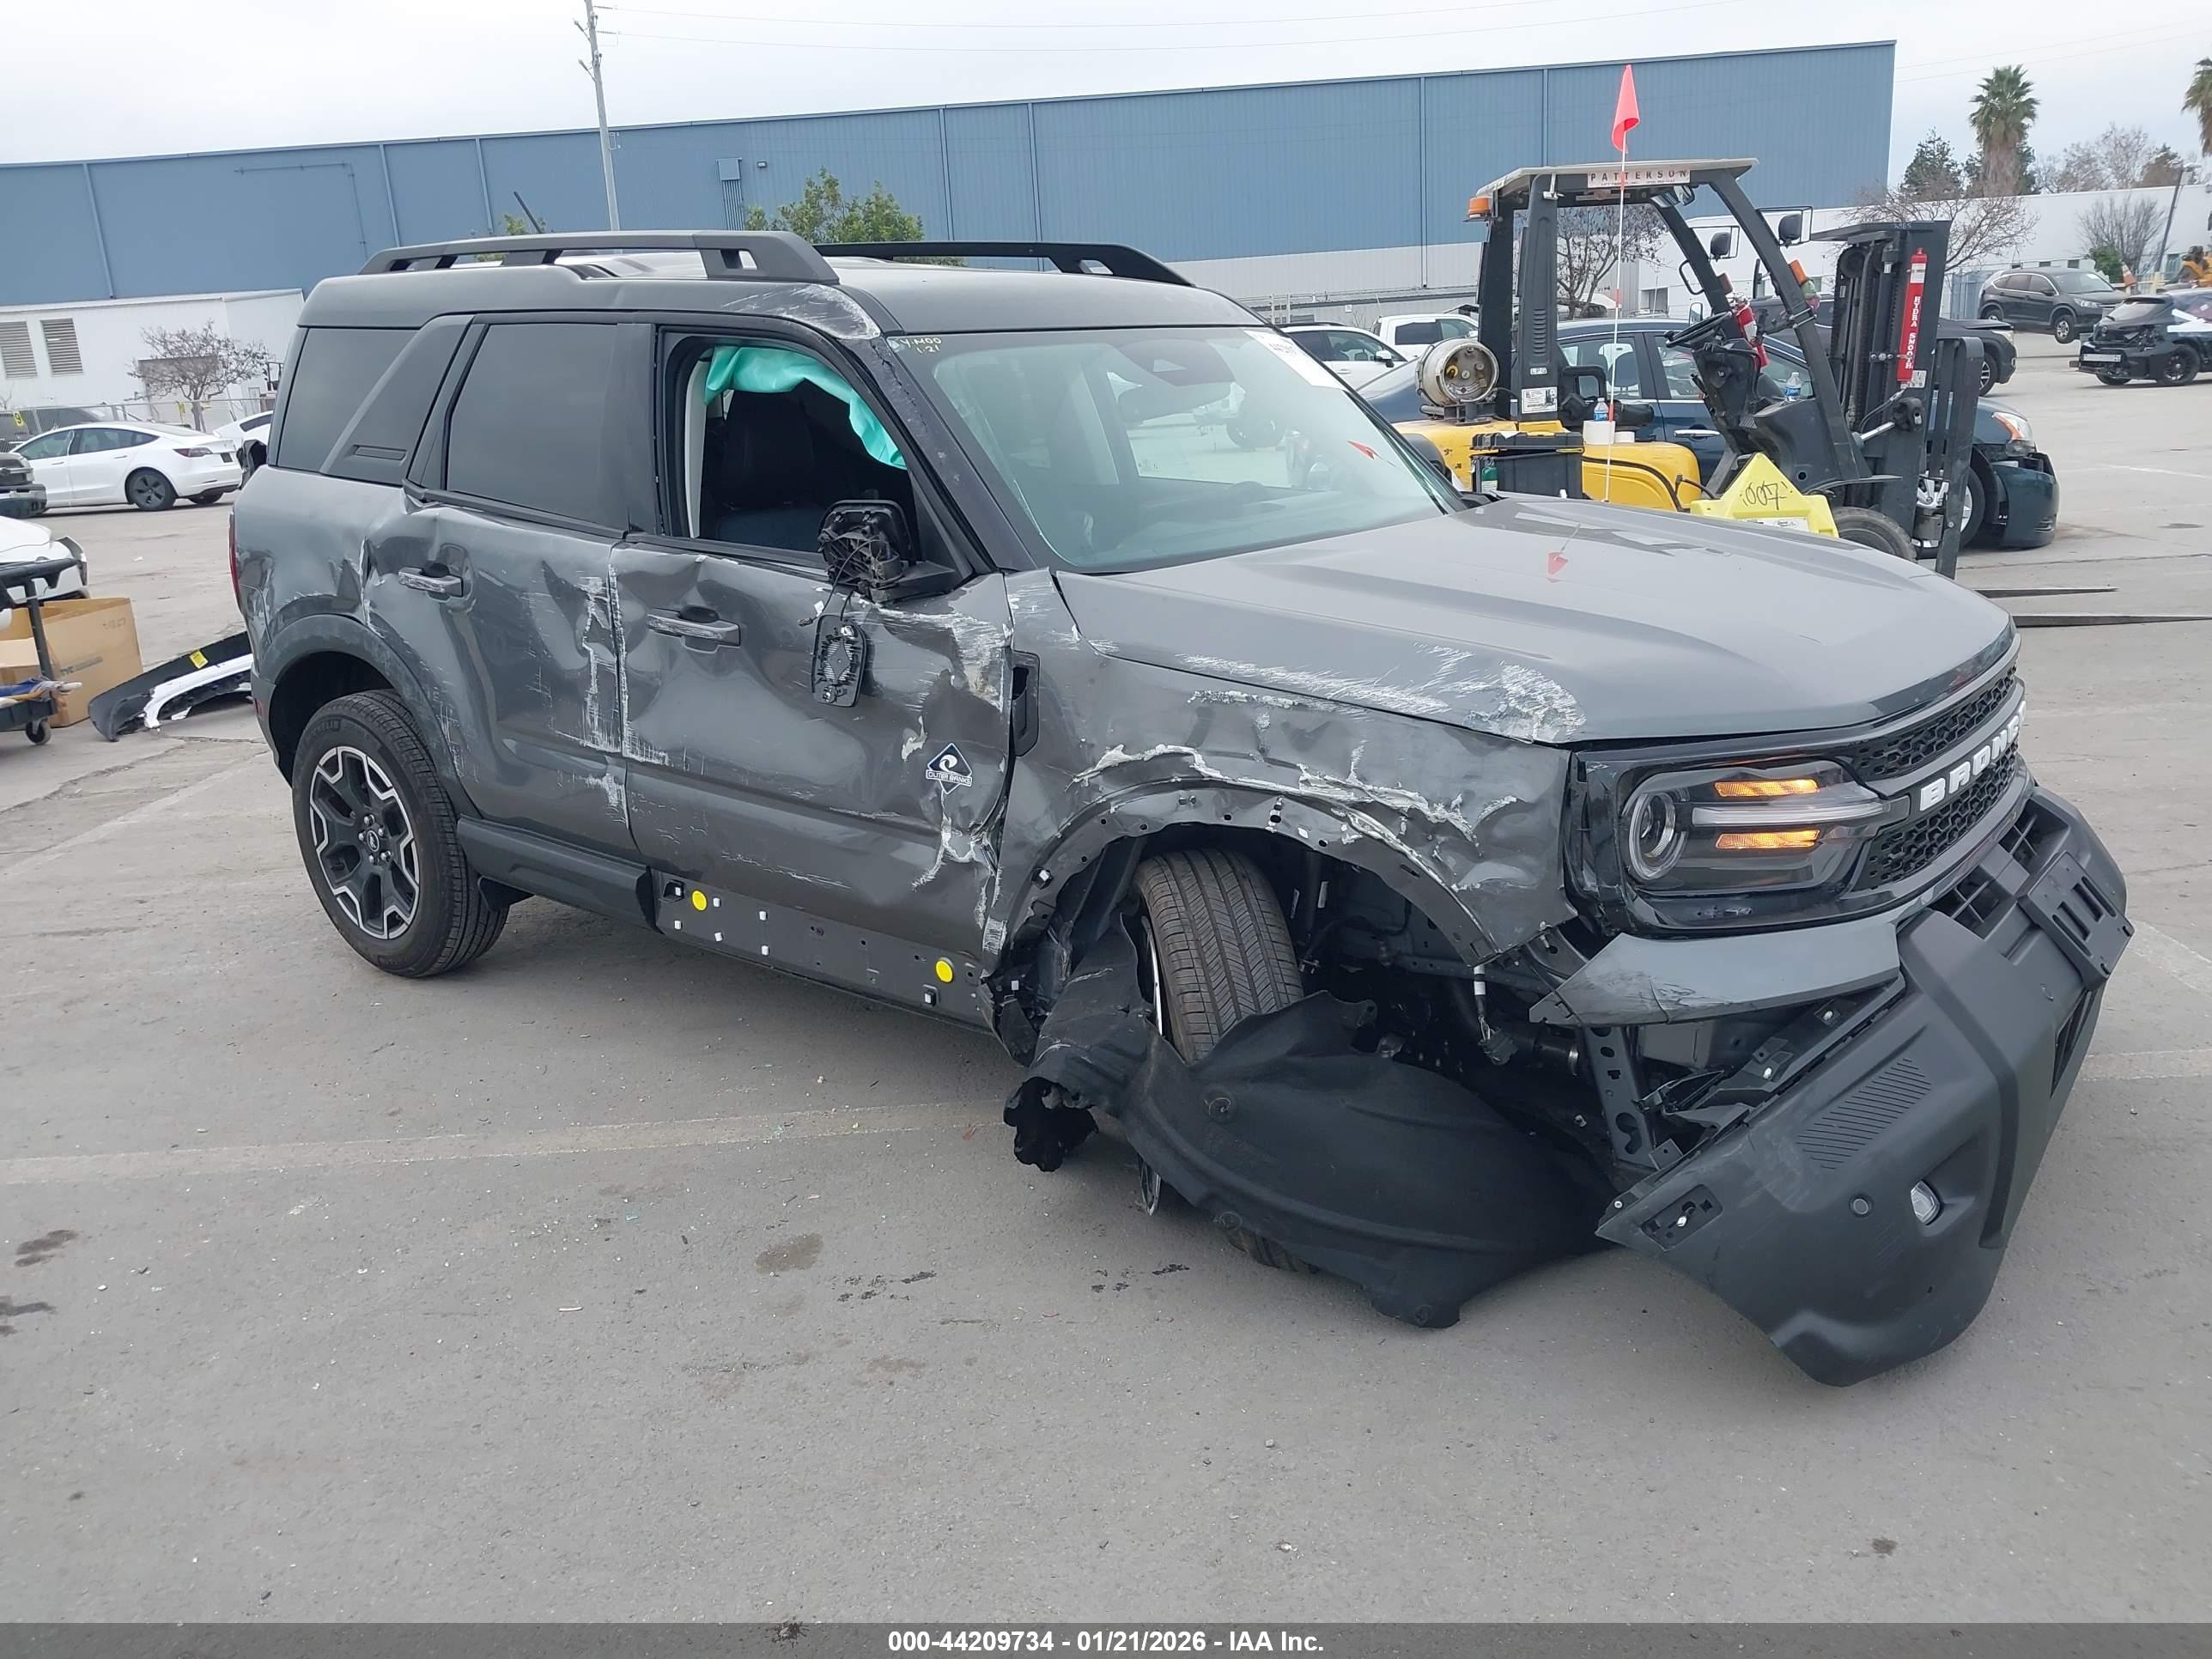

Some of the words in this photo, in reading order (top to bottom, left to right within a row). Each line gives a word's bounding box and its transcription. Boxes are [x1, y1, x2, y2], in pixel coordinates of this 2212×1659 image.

[1590, 170, 1687, 182] PATTERSON
[1910, 296, 1921, 327] HYDRA
[1905, 332, 1917, 369] SMOOTH
[928, 771, 949, 781] OUTER
[949, 775, 970, 785] BANKS
